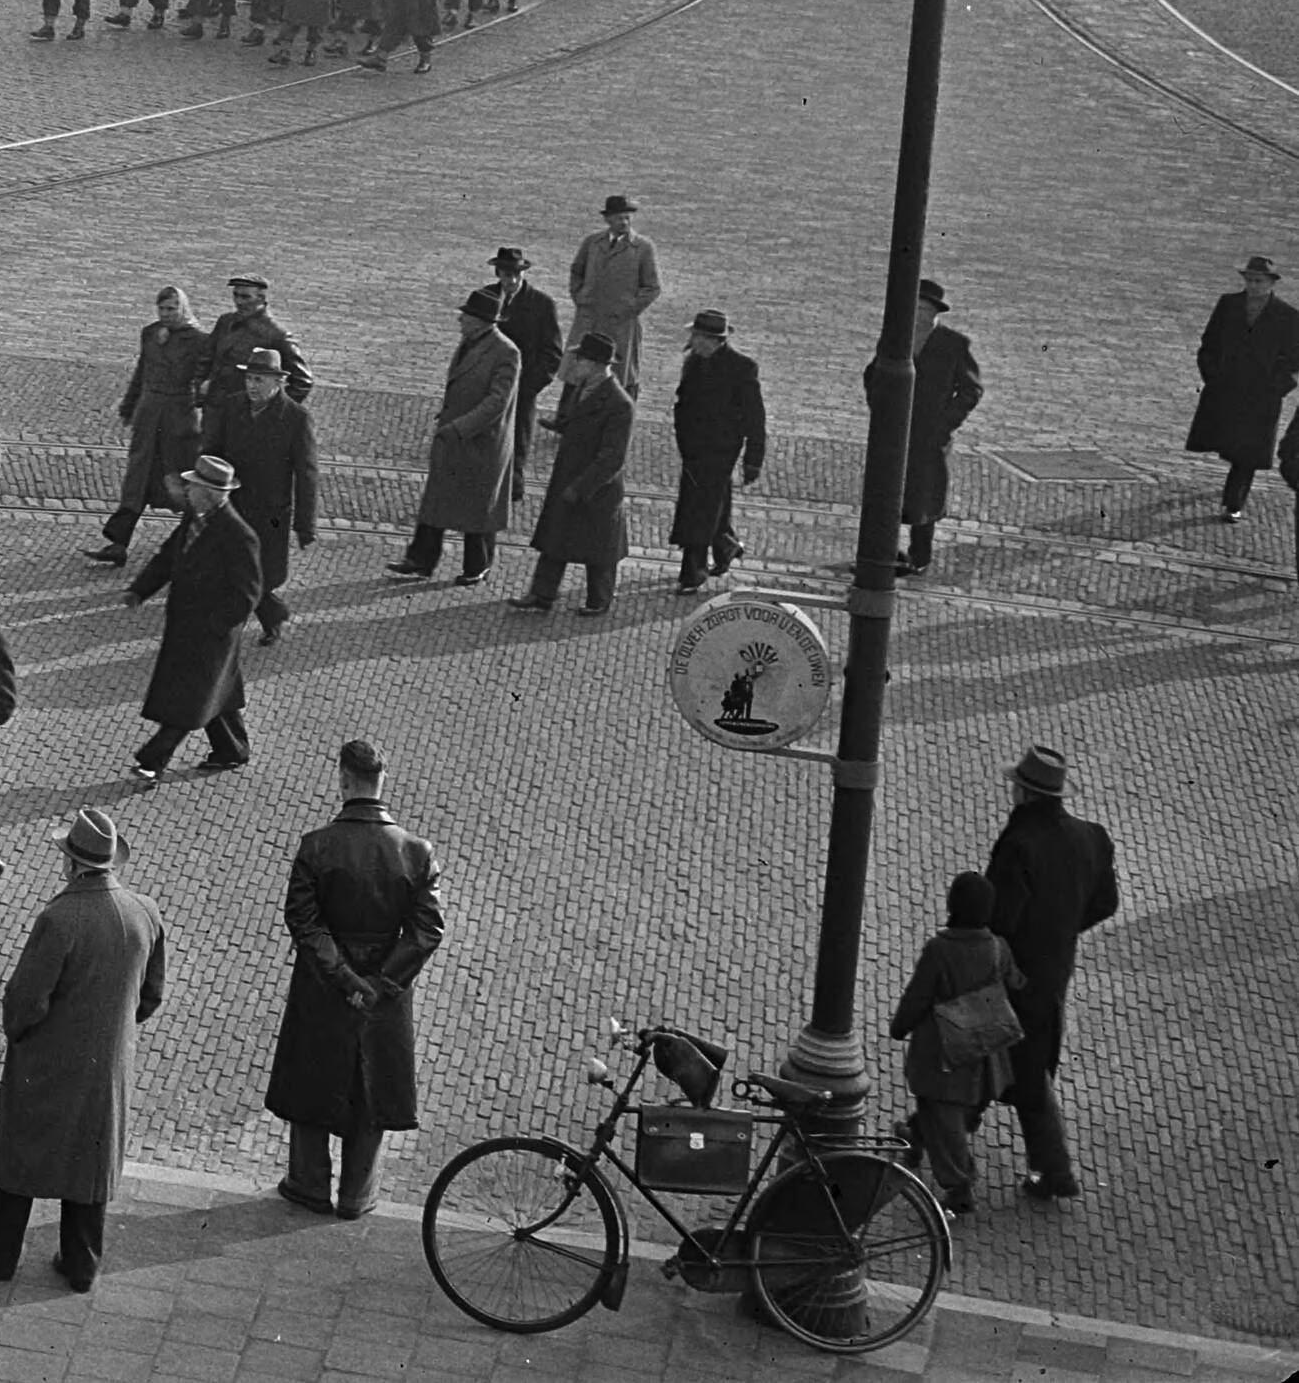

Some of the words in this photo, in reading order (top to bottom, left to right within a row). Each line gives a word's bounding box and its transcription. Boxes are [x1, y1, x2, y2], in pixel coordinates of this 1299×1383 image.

[702, 607, 741, 630] ZORGT
[744, 607, 779, 625] VOOR
[778, 617, 790, 630] U
[787, 623, 804, 641] EN
[678, 625, 706, 659] OLVEH
[799, 636, 817, 654] DE
[674, 659, 689, 675] DE
[808, 653, 826, 688] UWEN
